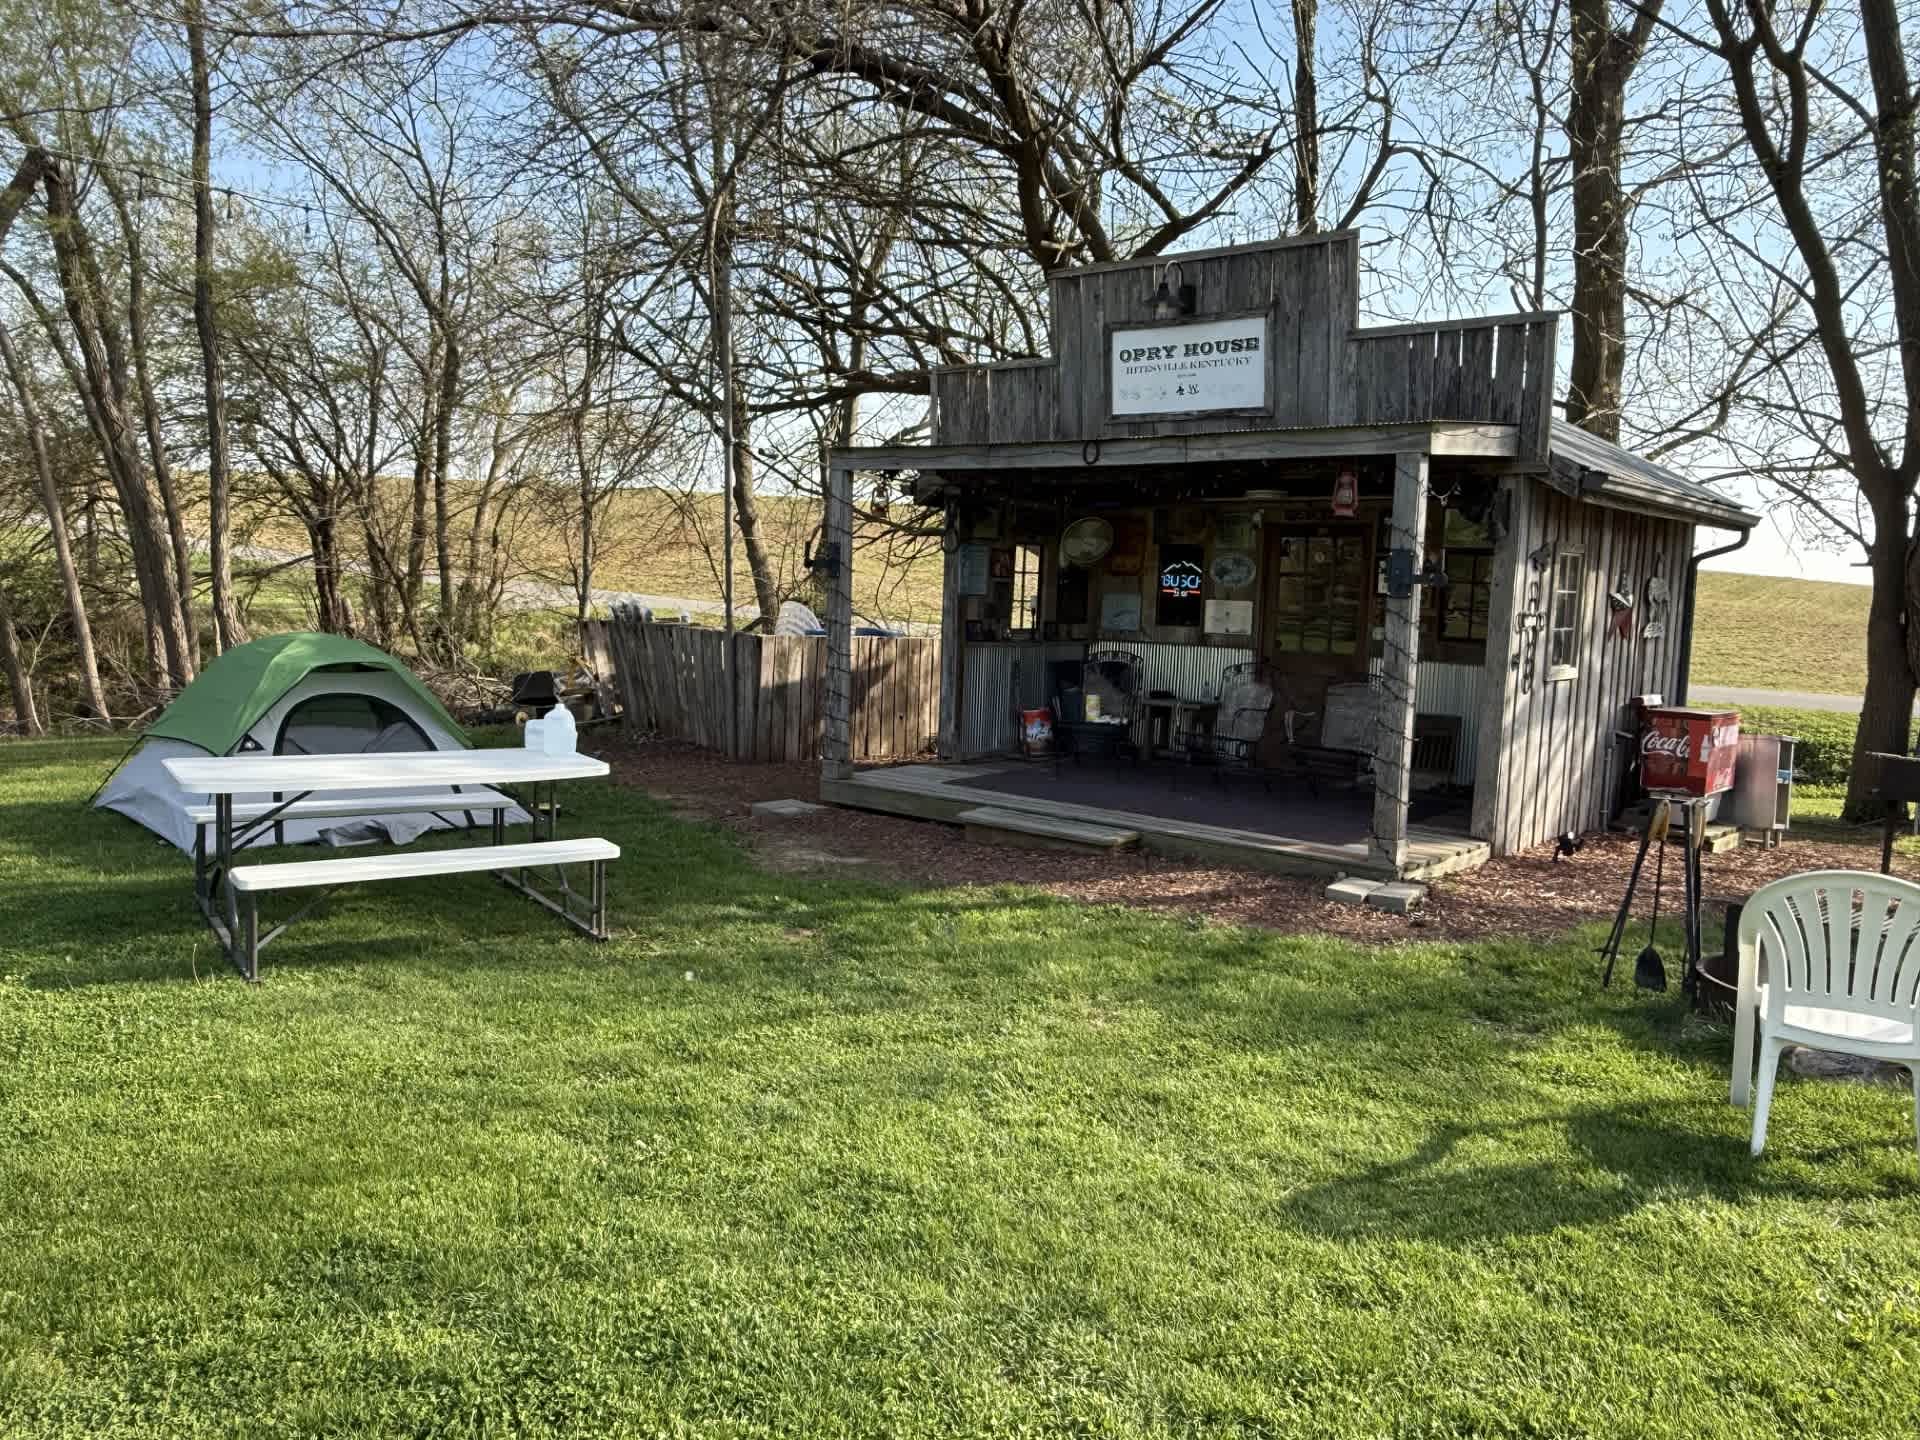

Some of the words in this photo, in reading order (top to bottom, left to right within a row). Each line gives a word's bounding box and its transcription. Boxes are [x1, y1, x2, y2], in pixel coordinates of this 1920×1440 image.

[1120, 345, 1177, 362] OPRY
[1184, 337, 1260, 357] HOUSE
[1189, 356, 1252, 370] KENTUCKY
